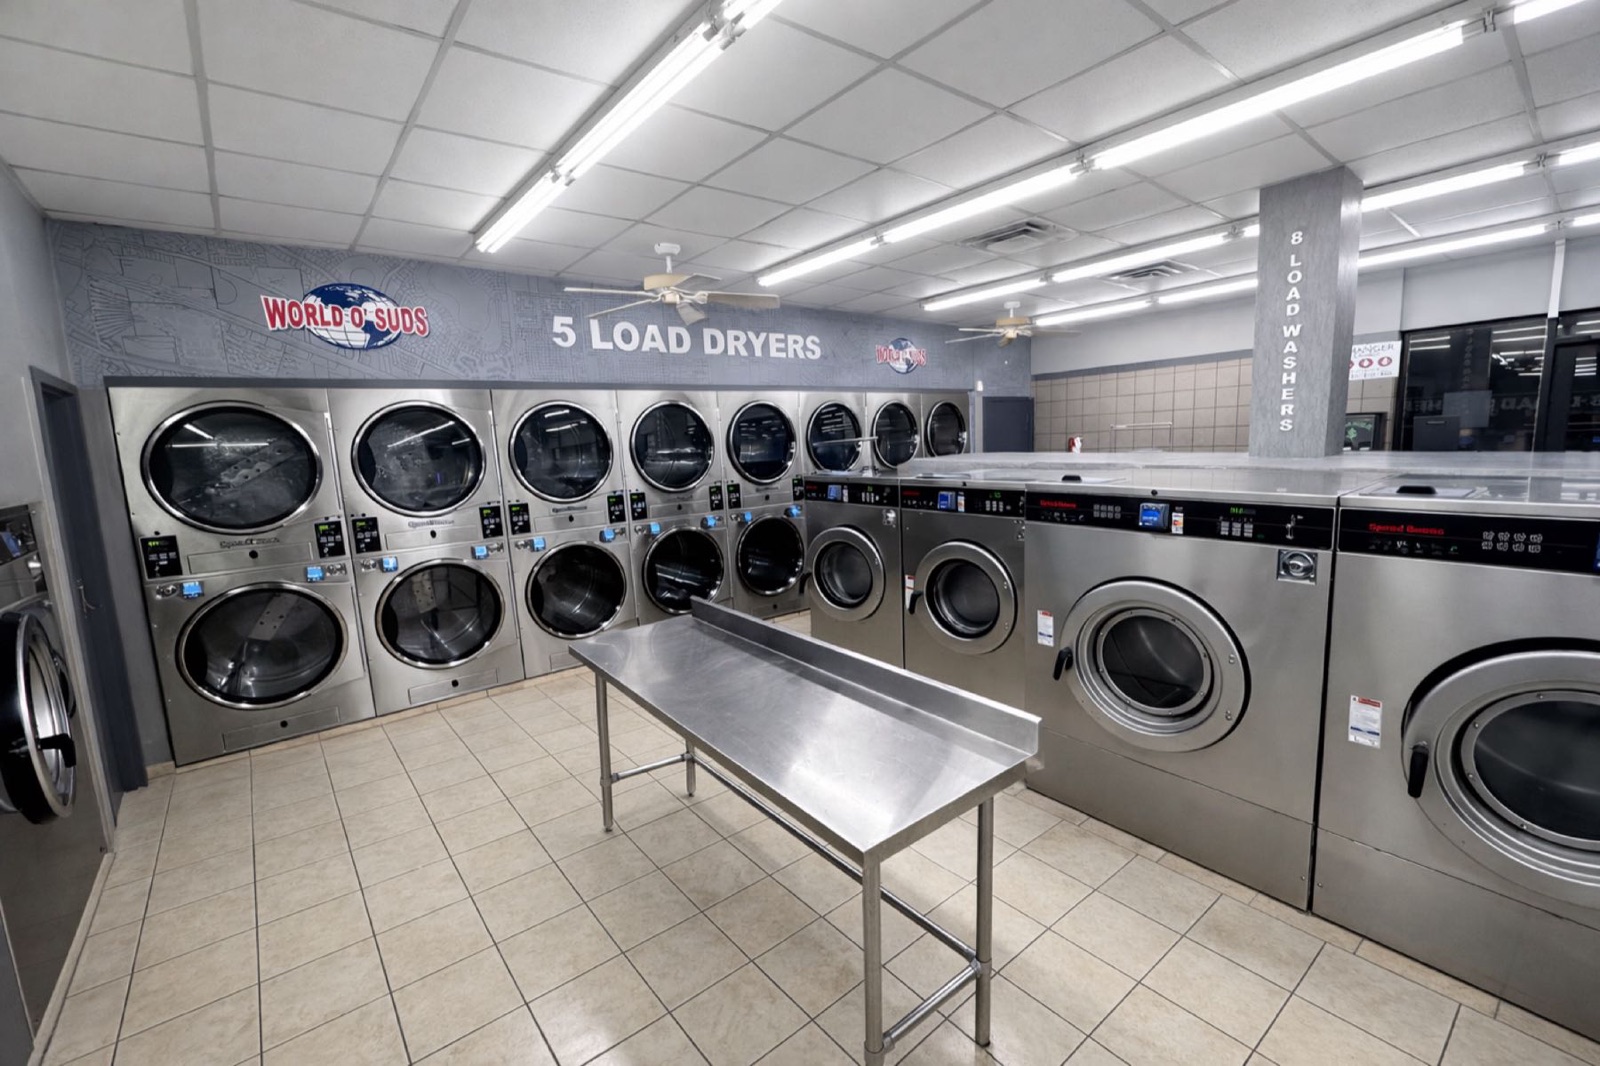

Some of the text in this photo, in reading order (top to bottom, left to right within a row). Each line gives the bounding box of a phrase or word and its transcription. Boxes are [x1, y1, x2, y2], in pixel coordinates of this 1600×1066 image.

[262, 296, 344, 329] WORLD
[374, 306, 429, 336] SUDS
[552, 315, 822, 360] 5 LOAD DRYERS
[1279, 230, 1303, 432] 8 LOAD WASHERS
